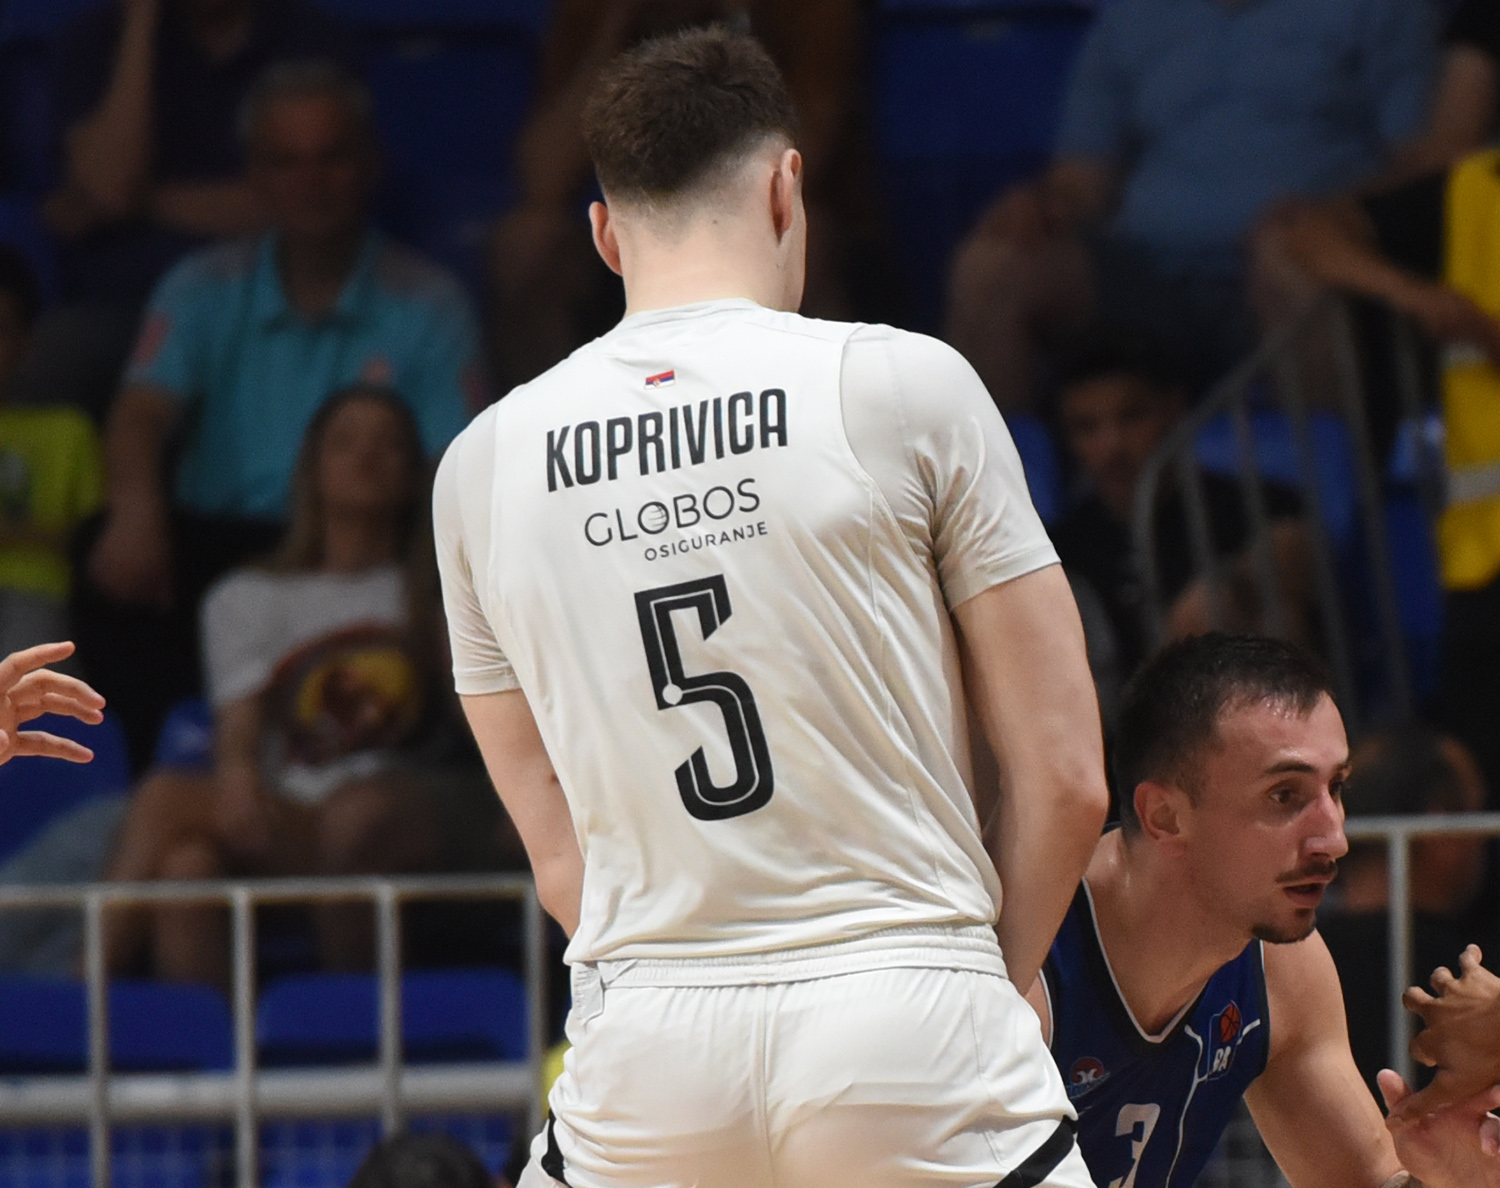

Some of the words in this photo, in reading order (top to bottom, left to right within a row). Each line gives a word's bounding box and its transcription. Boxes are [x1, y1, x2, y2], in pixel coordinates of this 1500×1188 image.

[547, 388, 789, 492] KOPRIVICA
[584, 478, 761, 547] GLOBOS
[644, 521, 768, 561] OSIGURANJE
[633, 573, 774, 821] 5
